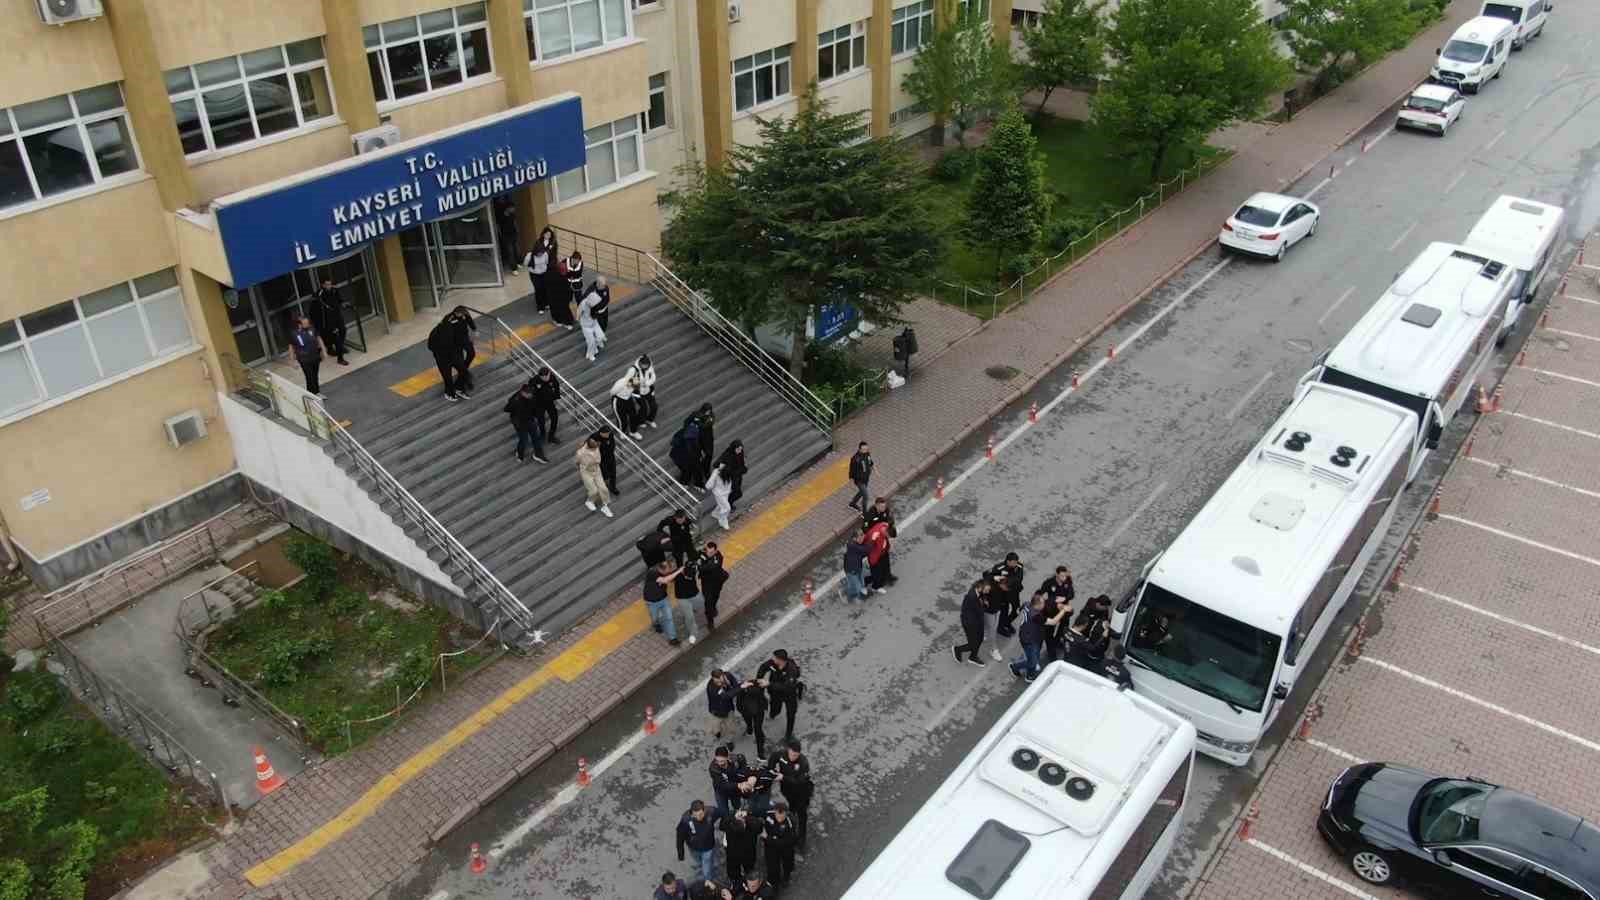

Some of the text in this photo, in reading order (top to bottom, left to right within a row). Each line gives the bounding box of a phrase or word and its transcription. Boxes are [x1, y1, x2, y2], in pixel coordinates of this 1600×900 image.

[333, 145, 513, 225] KAYSERİ VALİLİĞİ
[406, 152, 443, 175] T.C.
[295, 157, 548, 264] İL EMNİYET MÜDÜRLÜĞÜ
